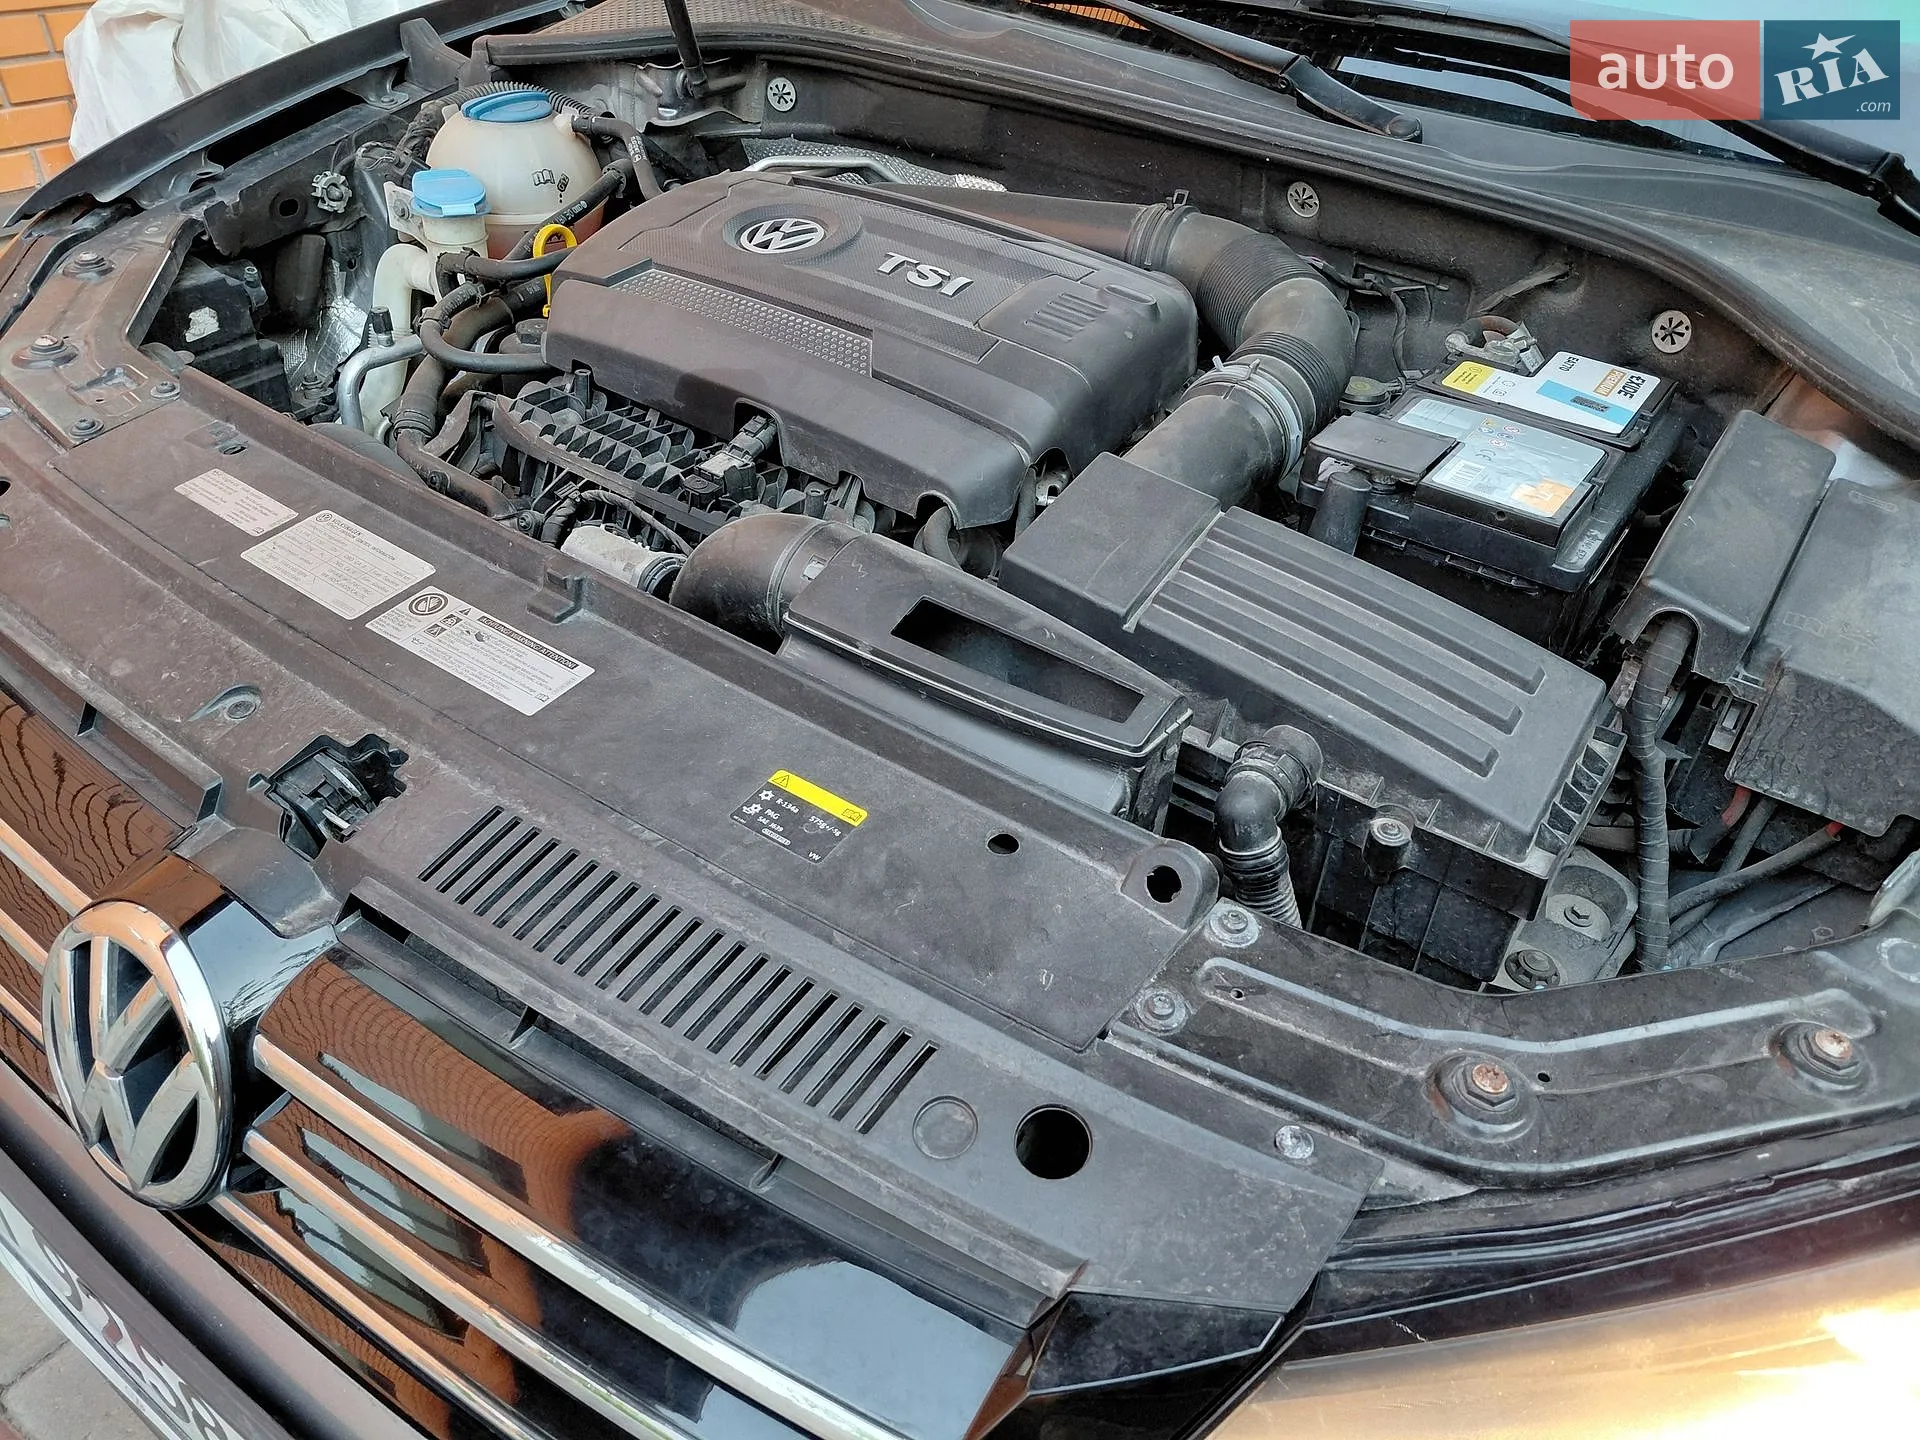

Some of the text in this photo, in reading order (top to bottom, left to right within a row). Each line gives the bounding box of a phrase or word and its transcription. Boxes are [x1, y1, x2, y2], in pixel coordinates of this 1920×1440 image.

[877, 251, 974, 298] TSI
[1617, 375, 1646, 399] EXIDE
[541, 648, 577, 669] ATTENTION!
[775, 798, 799, 813] R-134a
[757, 816, 770, 825] SAE
[764, 809, 780, 820] PAG
[808, 851, 821, 861] VW
